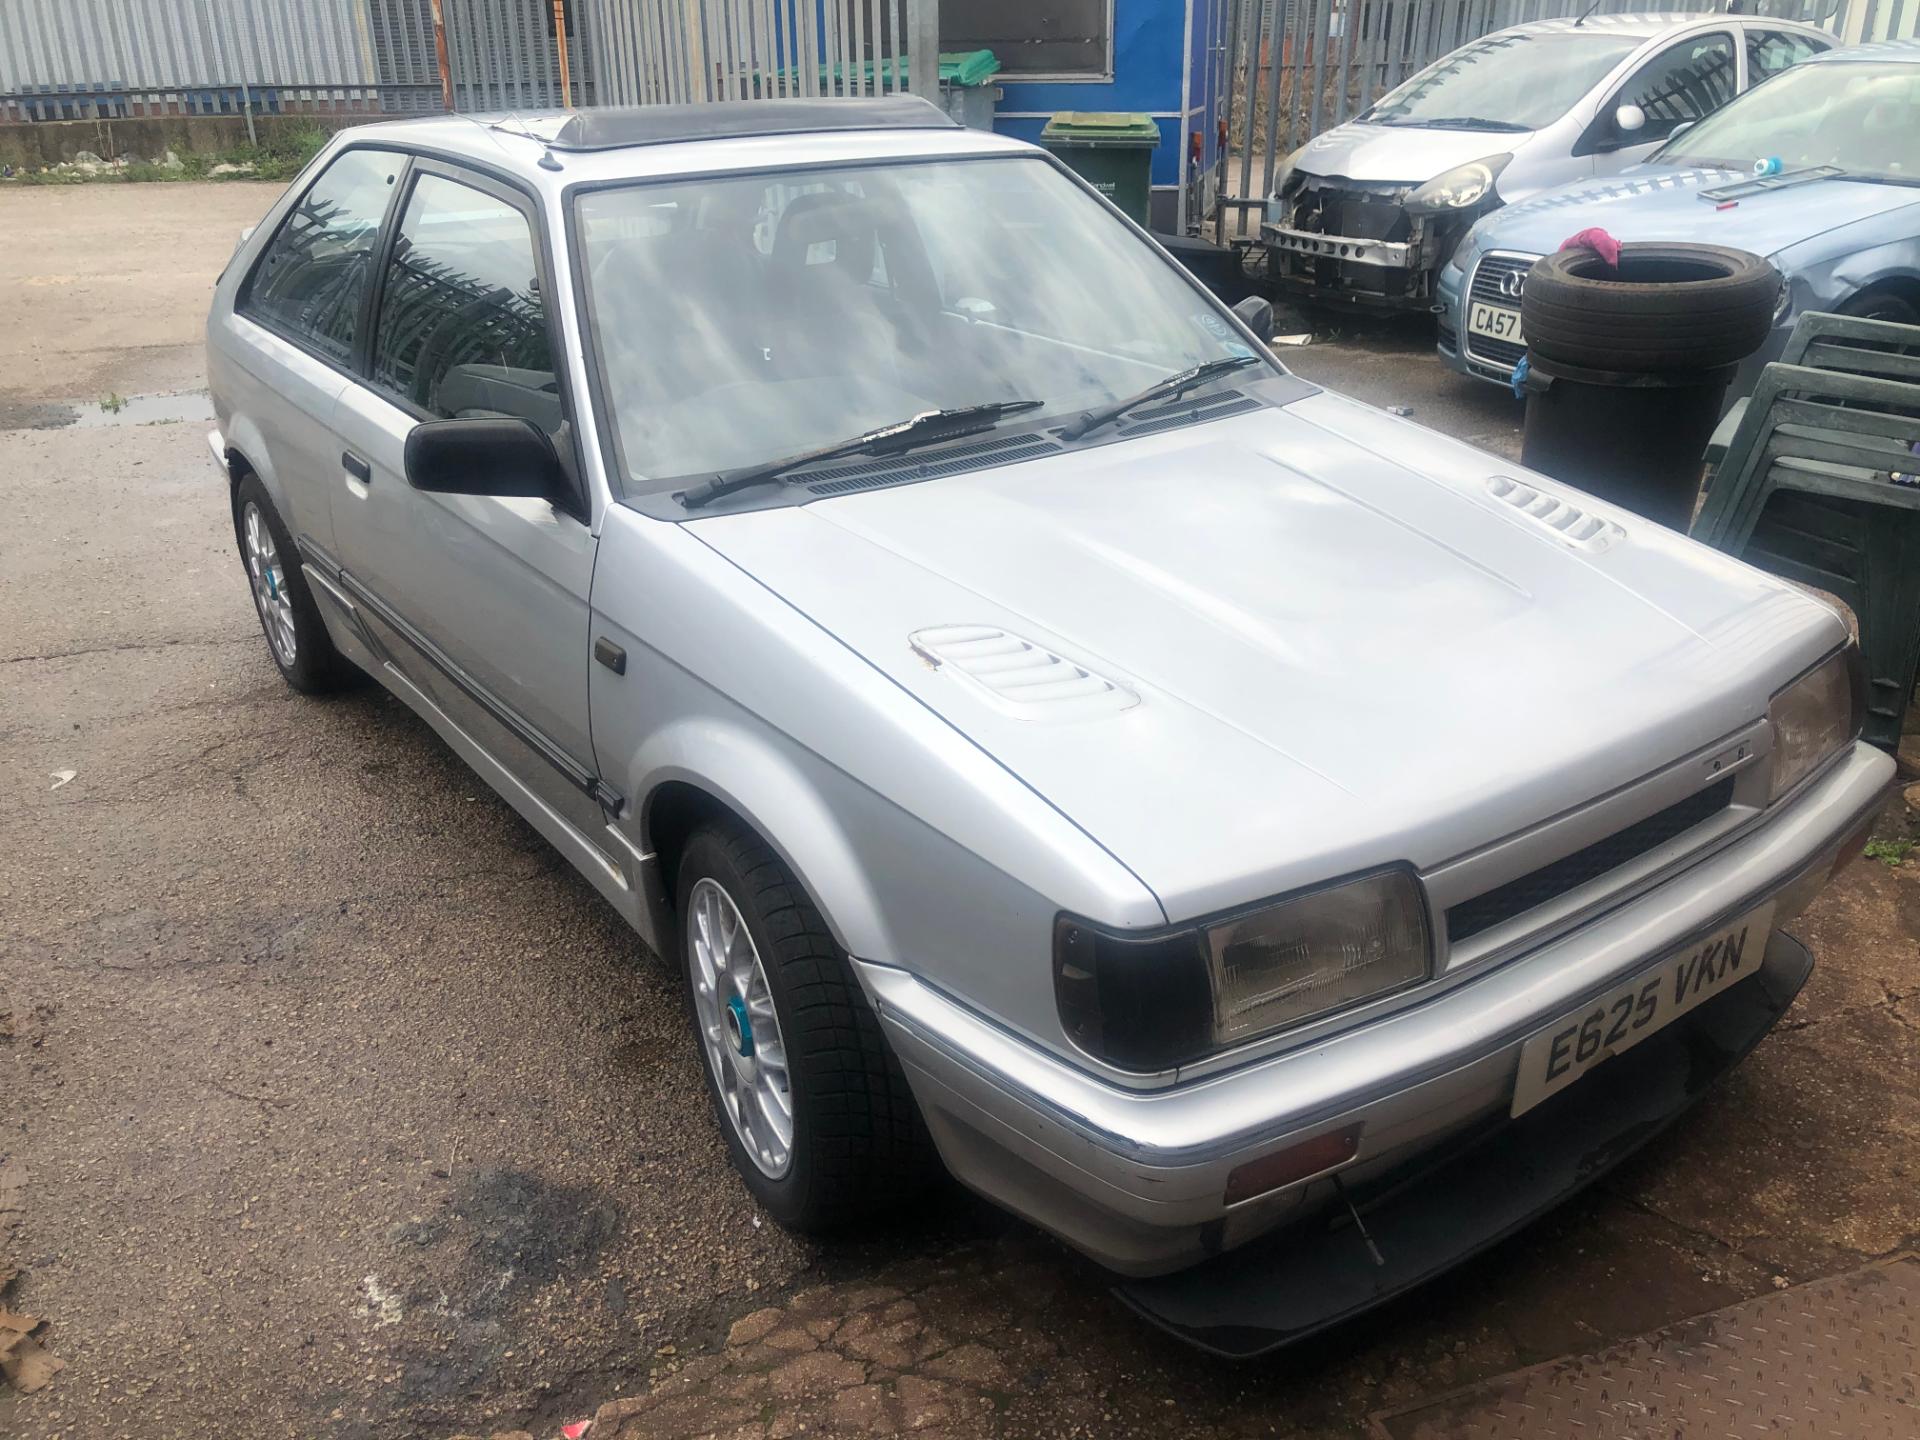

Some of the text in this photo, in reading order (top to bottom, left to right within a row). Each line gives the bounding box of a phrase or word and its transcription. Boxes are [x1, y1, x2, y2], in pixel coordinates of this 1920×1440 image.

[1475, 308, 1517, 337] CA57
[1545, 926, 1748, 1085] E625 VKN
